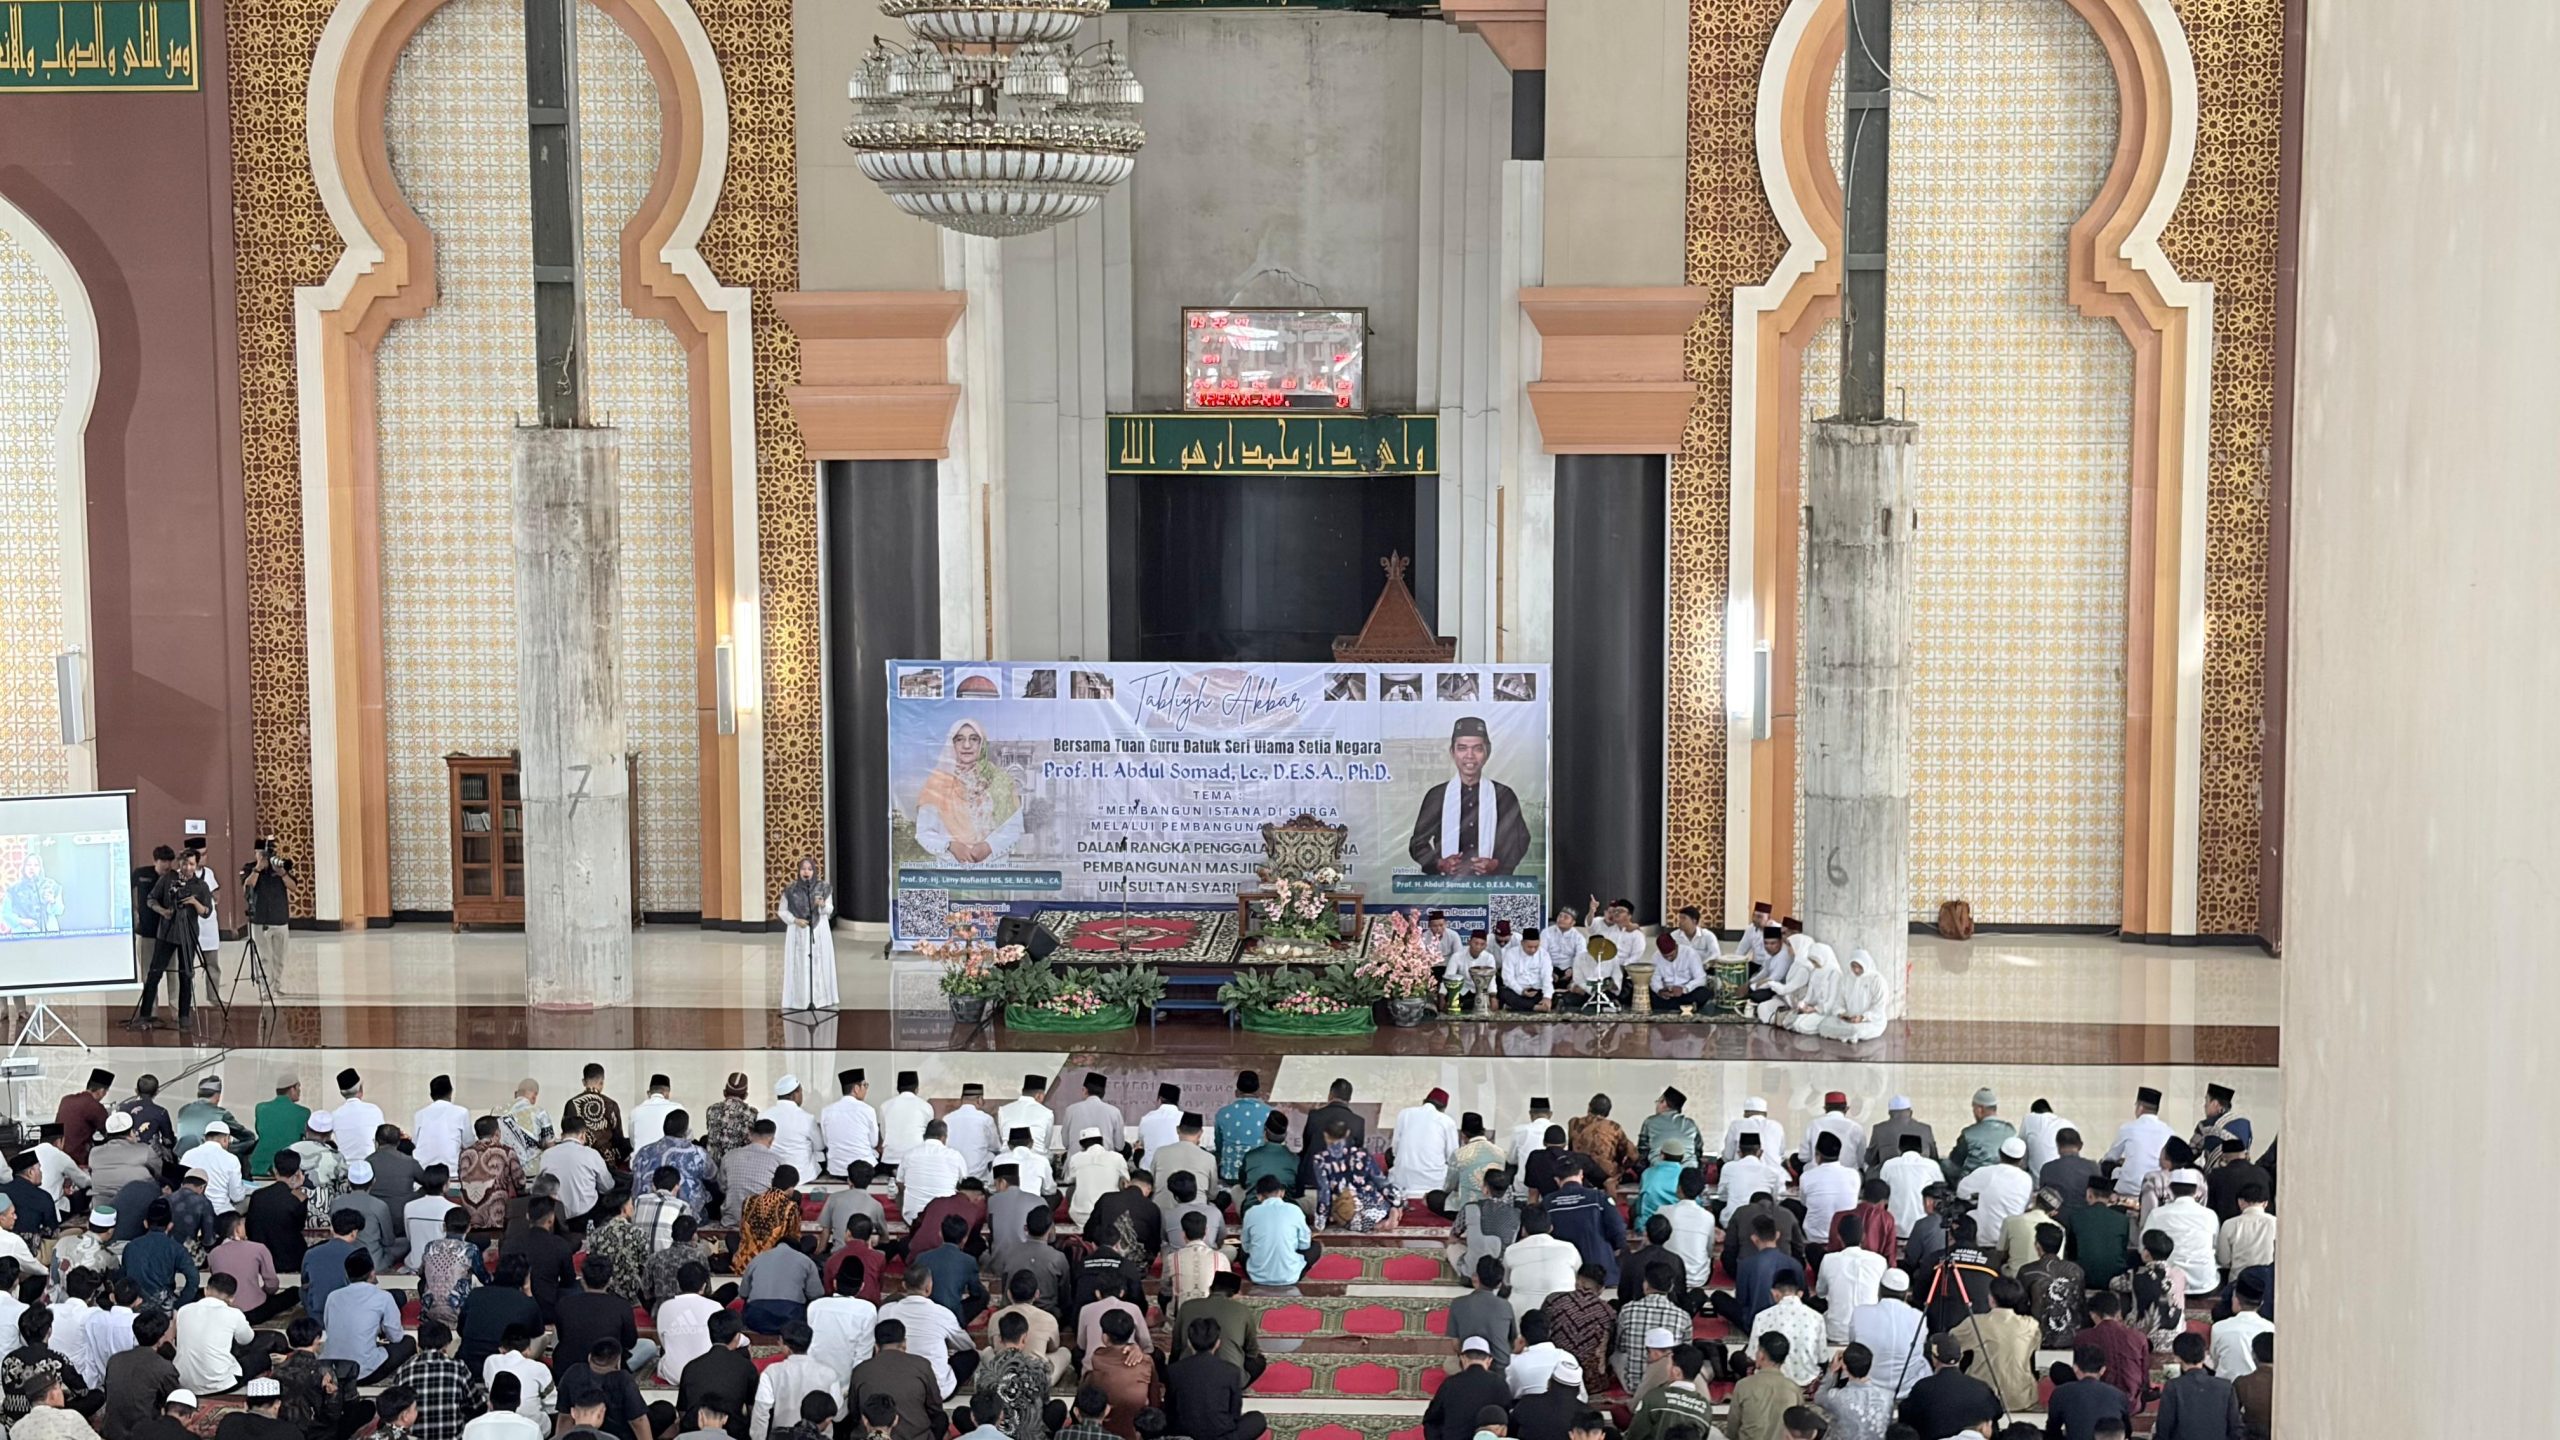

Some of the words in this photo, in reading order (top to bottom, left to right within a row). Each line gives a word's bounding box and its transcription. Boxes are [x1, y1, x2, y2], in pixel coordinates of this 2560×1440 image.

[1129, 669, 1213, 732] Tabligh
[1221, 674, 1306, 725] Akbar
[1053, 738, 1111, 753] Bersama
[1115, 738, 1145, 753] Tuan
[1150, 738, 1180, 754] Guru
[1184, 739, 1221, 754] Datuk
[1225, 739, 1250, 755] Seri
[1255, 740, 1294, 755] Ulama
[1299, 740, 1331, 755] Setia
[1336, 740, 1382, 756] Negara
[1044, 761, 1087, 778] Prof.
[1092, 762, 1108, 778] H.
[1114, 762, 1165, 779] Abdul
[1170, 763, 1236, 781] Somad,
[1240, 764, 1269, 781] Lc.,
[1273, 764, 1344, 782] D.E.S.A.,
[1348, 764, 1392, 781] Ph.D.
[567, 763, 593, 820] 7
[1193, 790, 1232, 800] TEMA
[1208, 806, 1261, 816] ISTANA
[1268, 807, 1282, 816] DI
[1289, 807, 1338, 817] SURGA
[1091, 821, 1154, 831] MELALUI
[1161, 821, 1264, 832] PEMBANGUNA
[1130, 842, 1191, 854] RANGKA
[1083, 861, 1201, 874] PEMBANGUNAN
[1826, 846, 1850, 888] 6
[1098, 881, 1125, 893] UIN
[1128, 881, 1187, 893] SULTAN
[1191, 882, 1241, 894] SYARI
[1396, 880, 1413, 888] Prof.
[1424, 880, 1445, 888] Abdul
